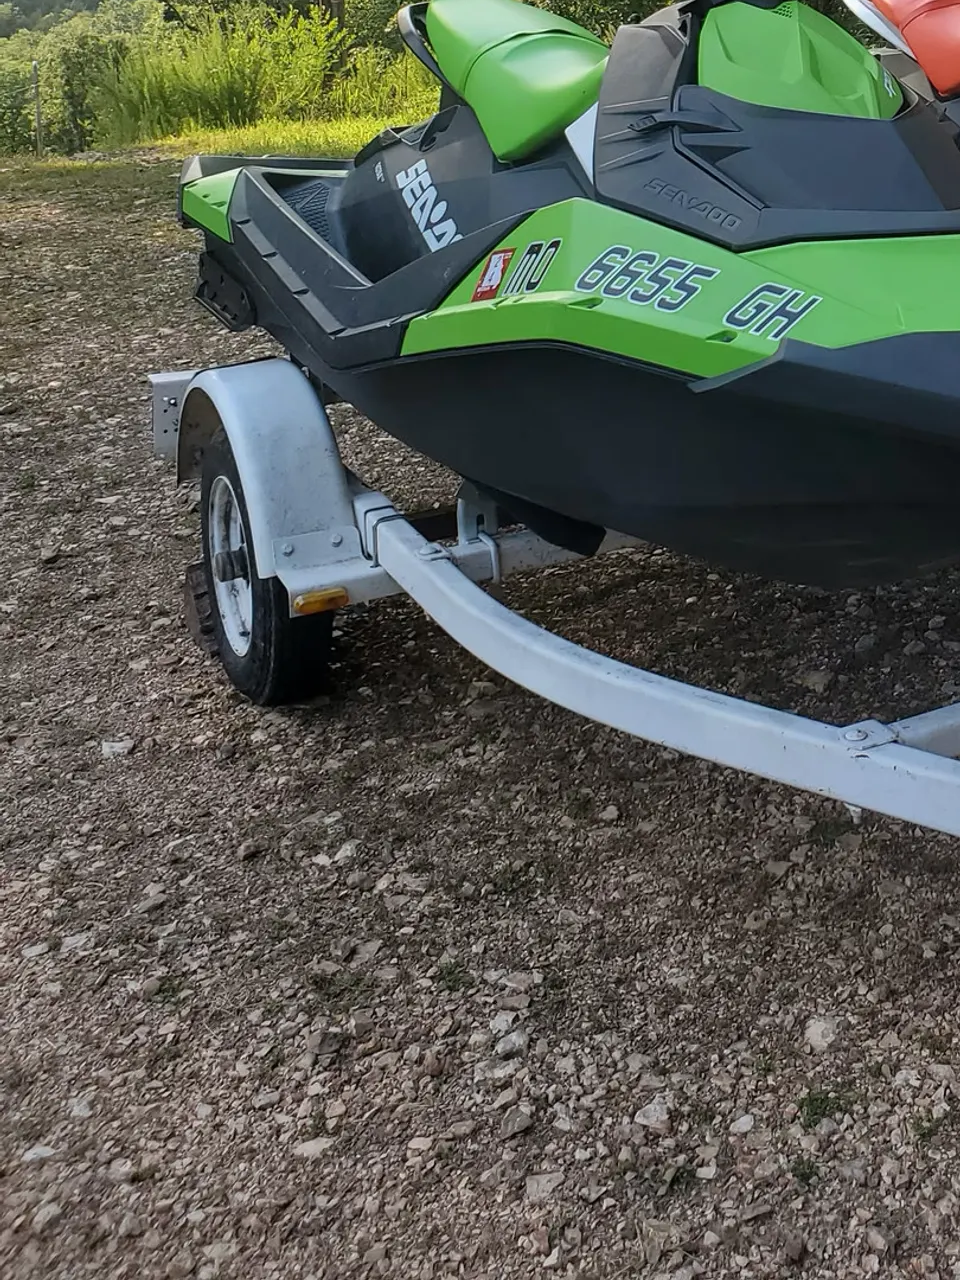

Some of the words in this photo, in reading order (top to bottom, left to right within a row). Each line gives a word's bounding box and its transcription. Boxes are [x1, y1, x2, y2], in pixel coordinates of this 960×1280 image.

[501, 237, 563, 297] MO
[574, 245, 721, 313] 6655
[722, 282, 823, 340] GH
